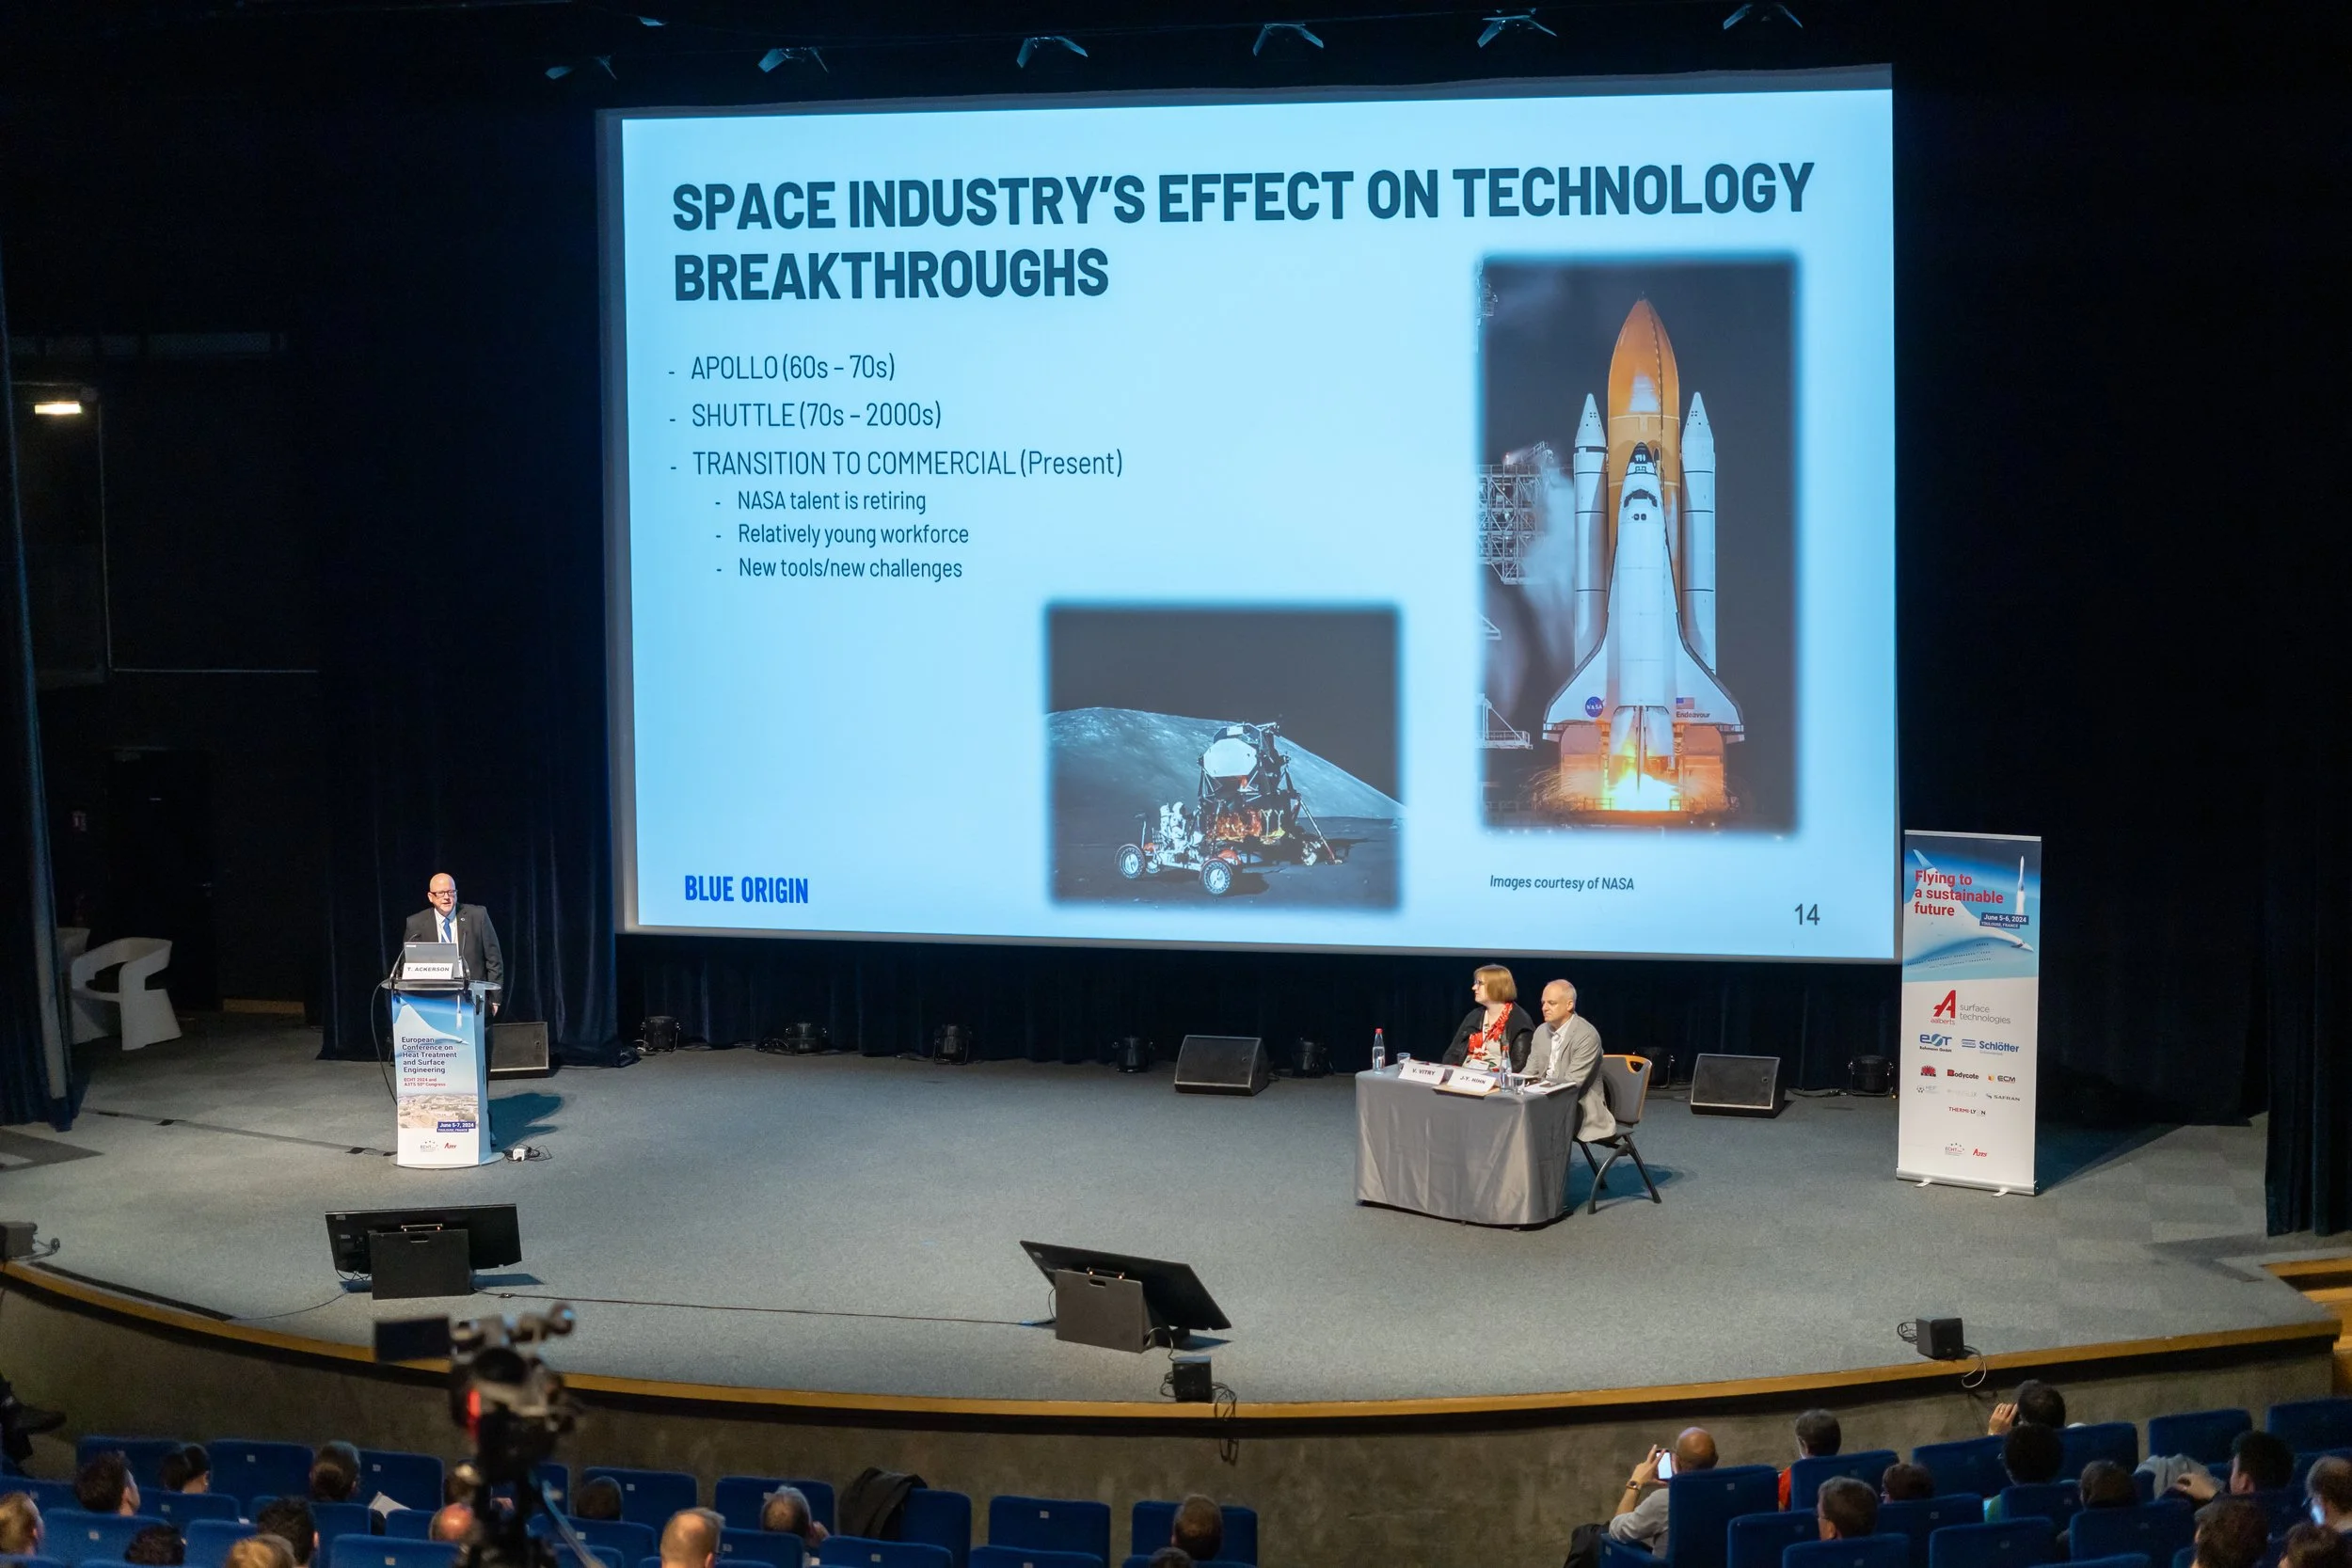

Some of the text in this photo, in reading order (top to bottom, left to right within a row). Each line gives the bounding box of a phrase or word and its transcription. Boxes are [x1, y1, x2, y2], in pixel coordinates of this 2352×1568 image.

[674, 182, 835, 231] SPACE
[1159, 171, 1354, 222] EFFECT
[1368, 169, 1438, 219] ON
[1453, 162, 1815, 217] TECHNOLOGY
[675, 248, 1108, 301] BREAKTHROUGHS
[691, 356, 777, 379] APOLLO
[783, 354, 828, 382] (60s
[850, 353, 894, 381] 70s)
[692, 404, 795, 426] SHUTTLE
[801, 402, 844, 429] (70s
[866, 401, 941, 429] 2000s)
[692, 449, 1121, 477] TRANSITION TO COMMERCIAL (Present)
[739, 491, 925, 515] NASA talent is retiring
[739, 524, 968, 547] Relatively young workforce
[739, 558, 961, 582] New tools/new challenges
[685, 875, 808, 903] BLUE ORIGIN
[1490, 875, 1633, 892] Images courtesy of NASA
[1915, 870, 1972, 887] Flying to
[1915, 889, 2004, 904] a sustainable
[1795, 904, 1820, 925] 14
[1915, 901, 1955, 916] future
[1960, 1003, 1990, 1013] surface
[1960, 1012, 2010, 1024] technologies
[1979, 1040, 2019, 1053] Schlötter
[1947, 1069, 1979, 1080] Bodycote
